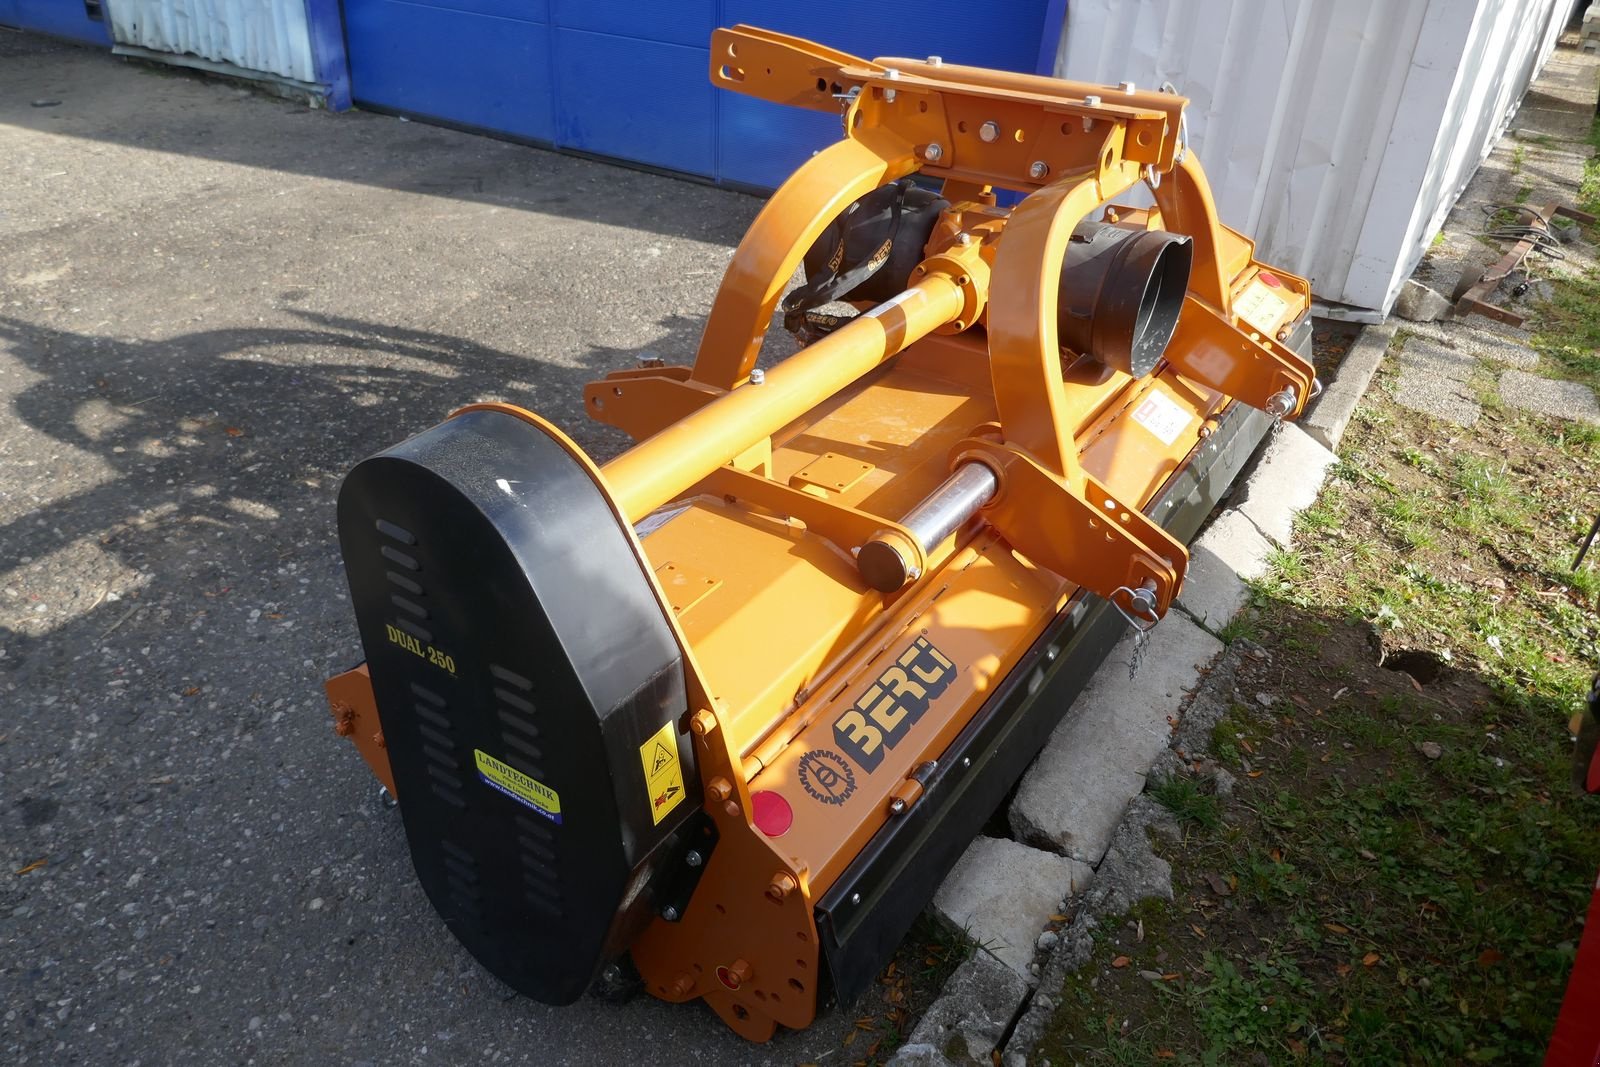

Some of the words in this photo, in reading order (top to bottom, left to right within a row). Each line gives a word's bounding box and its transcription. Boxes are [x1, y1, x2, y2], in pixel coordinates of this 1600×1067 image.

[385, 623, 425, 658] DUAL
[427, 646, 456, 673] 250
[478, 752, 556, 803] LANDTECHNIK
